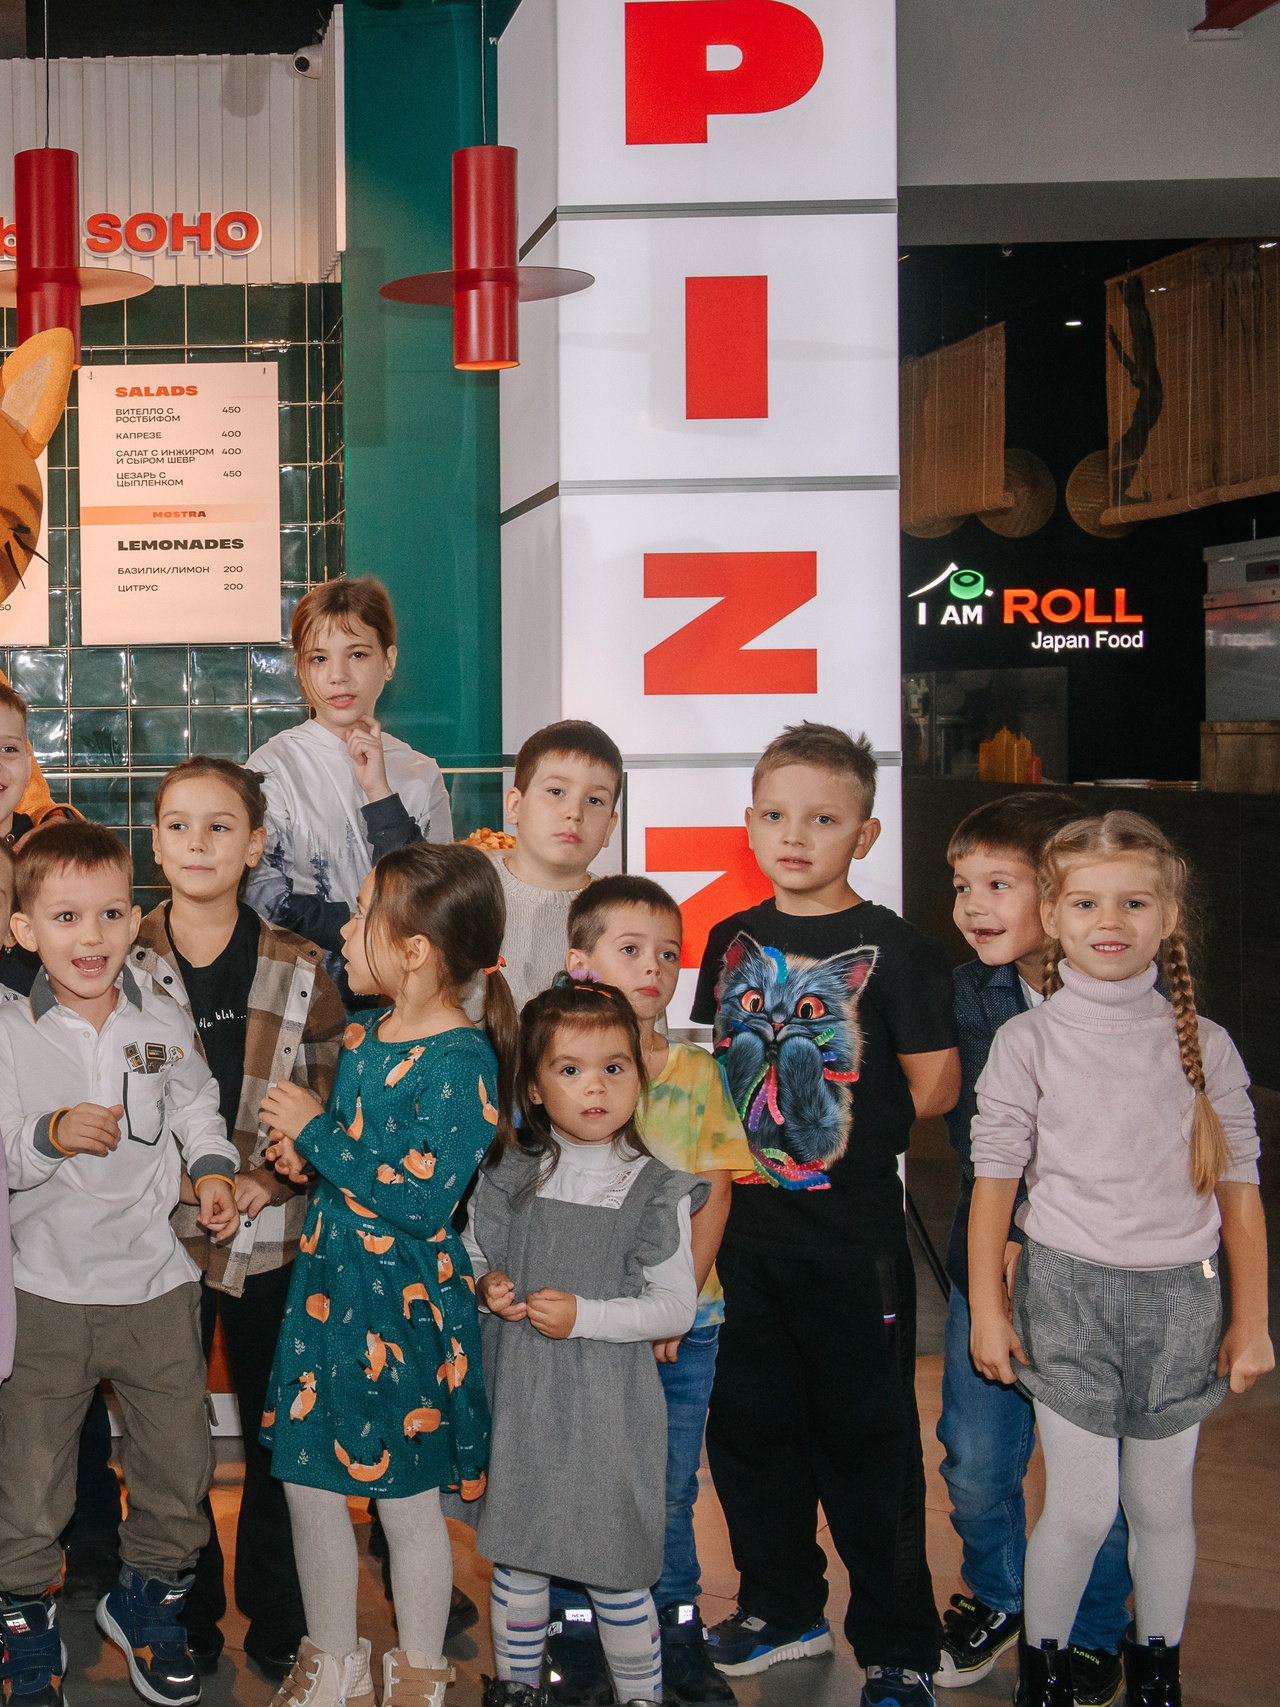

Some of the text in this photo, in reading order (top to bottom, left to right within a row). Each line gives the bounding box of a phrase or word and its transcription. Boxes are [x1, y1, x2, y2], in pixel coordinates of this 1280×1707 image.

[86, 210, 260, 253] SOHO
[115, 385, 199, 397] SALADS
[116, 407, 164, 415] ВИТЕЛЛО
[116, 415, 181, 423] РОСТБИФОМ
[116, 430, 242, 440] КАПРЕЗЕ 400
[116, 449, 149, 457] САЛАТ
[161, 448, 214, 456] ИНЖИРОМ
[221, 447, 242, 455] 400
[126, 456, 165, 464] СЫРОМ
[167, 456, 195, 464] ШЕВР
[116, 472, 157, 480] ЦЕЗАРЬ
[116, 479, 184, 487] ЦЫПЛЕНКОМ
[152, 510, 207, 518] MOSTRA
[117, 538, 245, 551] LEMONADES
[117, 565, 243, 575] БАЗИЛИК/ЛИМОН 200
[118, 584, 159, 592] ЦИТРУС
[918, 587, 1144, 625] I AM ROLL
[1031, 630, 1144, 653] Japan Food
